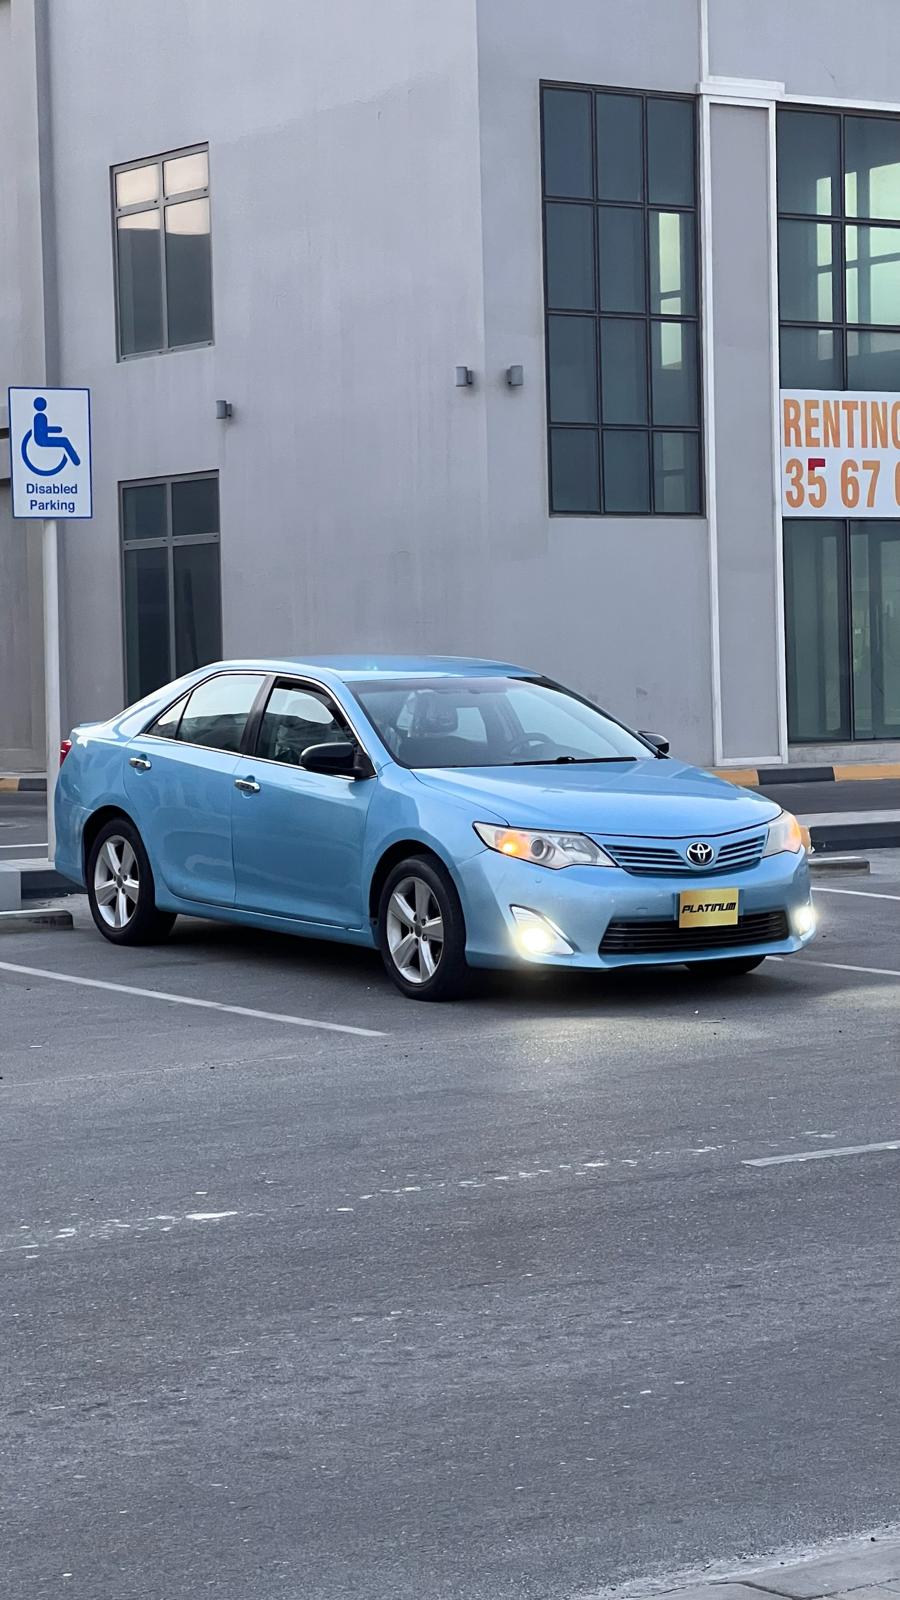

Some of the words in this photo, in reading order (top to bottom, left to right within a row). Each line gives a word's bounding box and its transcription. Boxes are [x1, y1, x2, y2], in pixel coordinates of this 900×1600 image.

[26, 483, 78, 494] Disabled
[785, 457, 827, 509] 35
[840, 458, 881, 509] 67
[29, 499, 76, 513] Parking
[681, 902, 737, 914] PLATINUM
